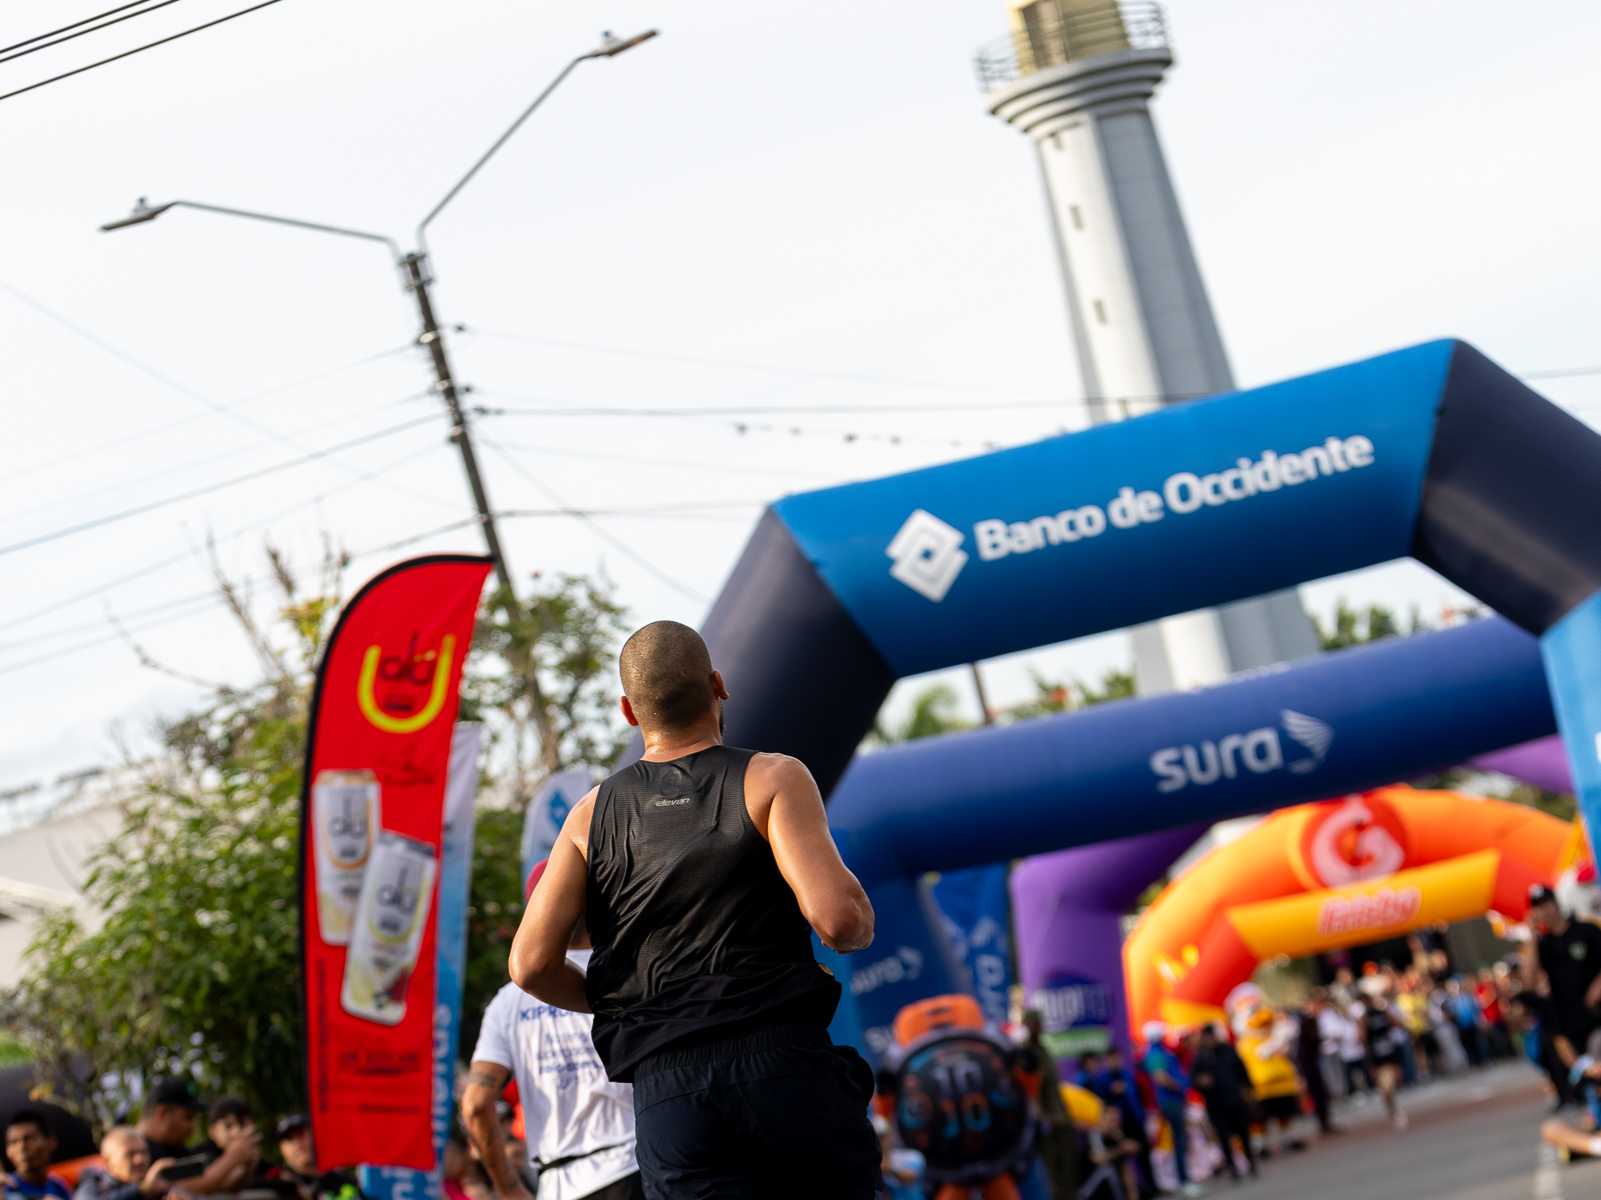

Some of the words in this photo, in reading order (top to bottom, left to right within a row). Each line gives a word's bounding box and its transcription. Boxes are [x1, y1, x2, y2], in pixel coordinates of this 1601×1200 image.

[973, 505, 1106, 561] Banco
[1108, 487, 1165, 528] de
[1164, 434, 1374, 514] Occidente
[1151, 727, 1283, 793] sura
